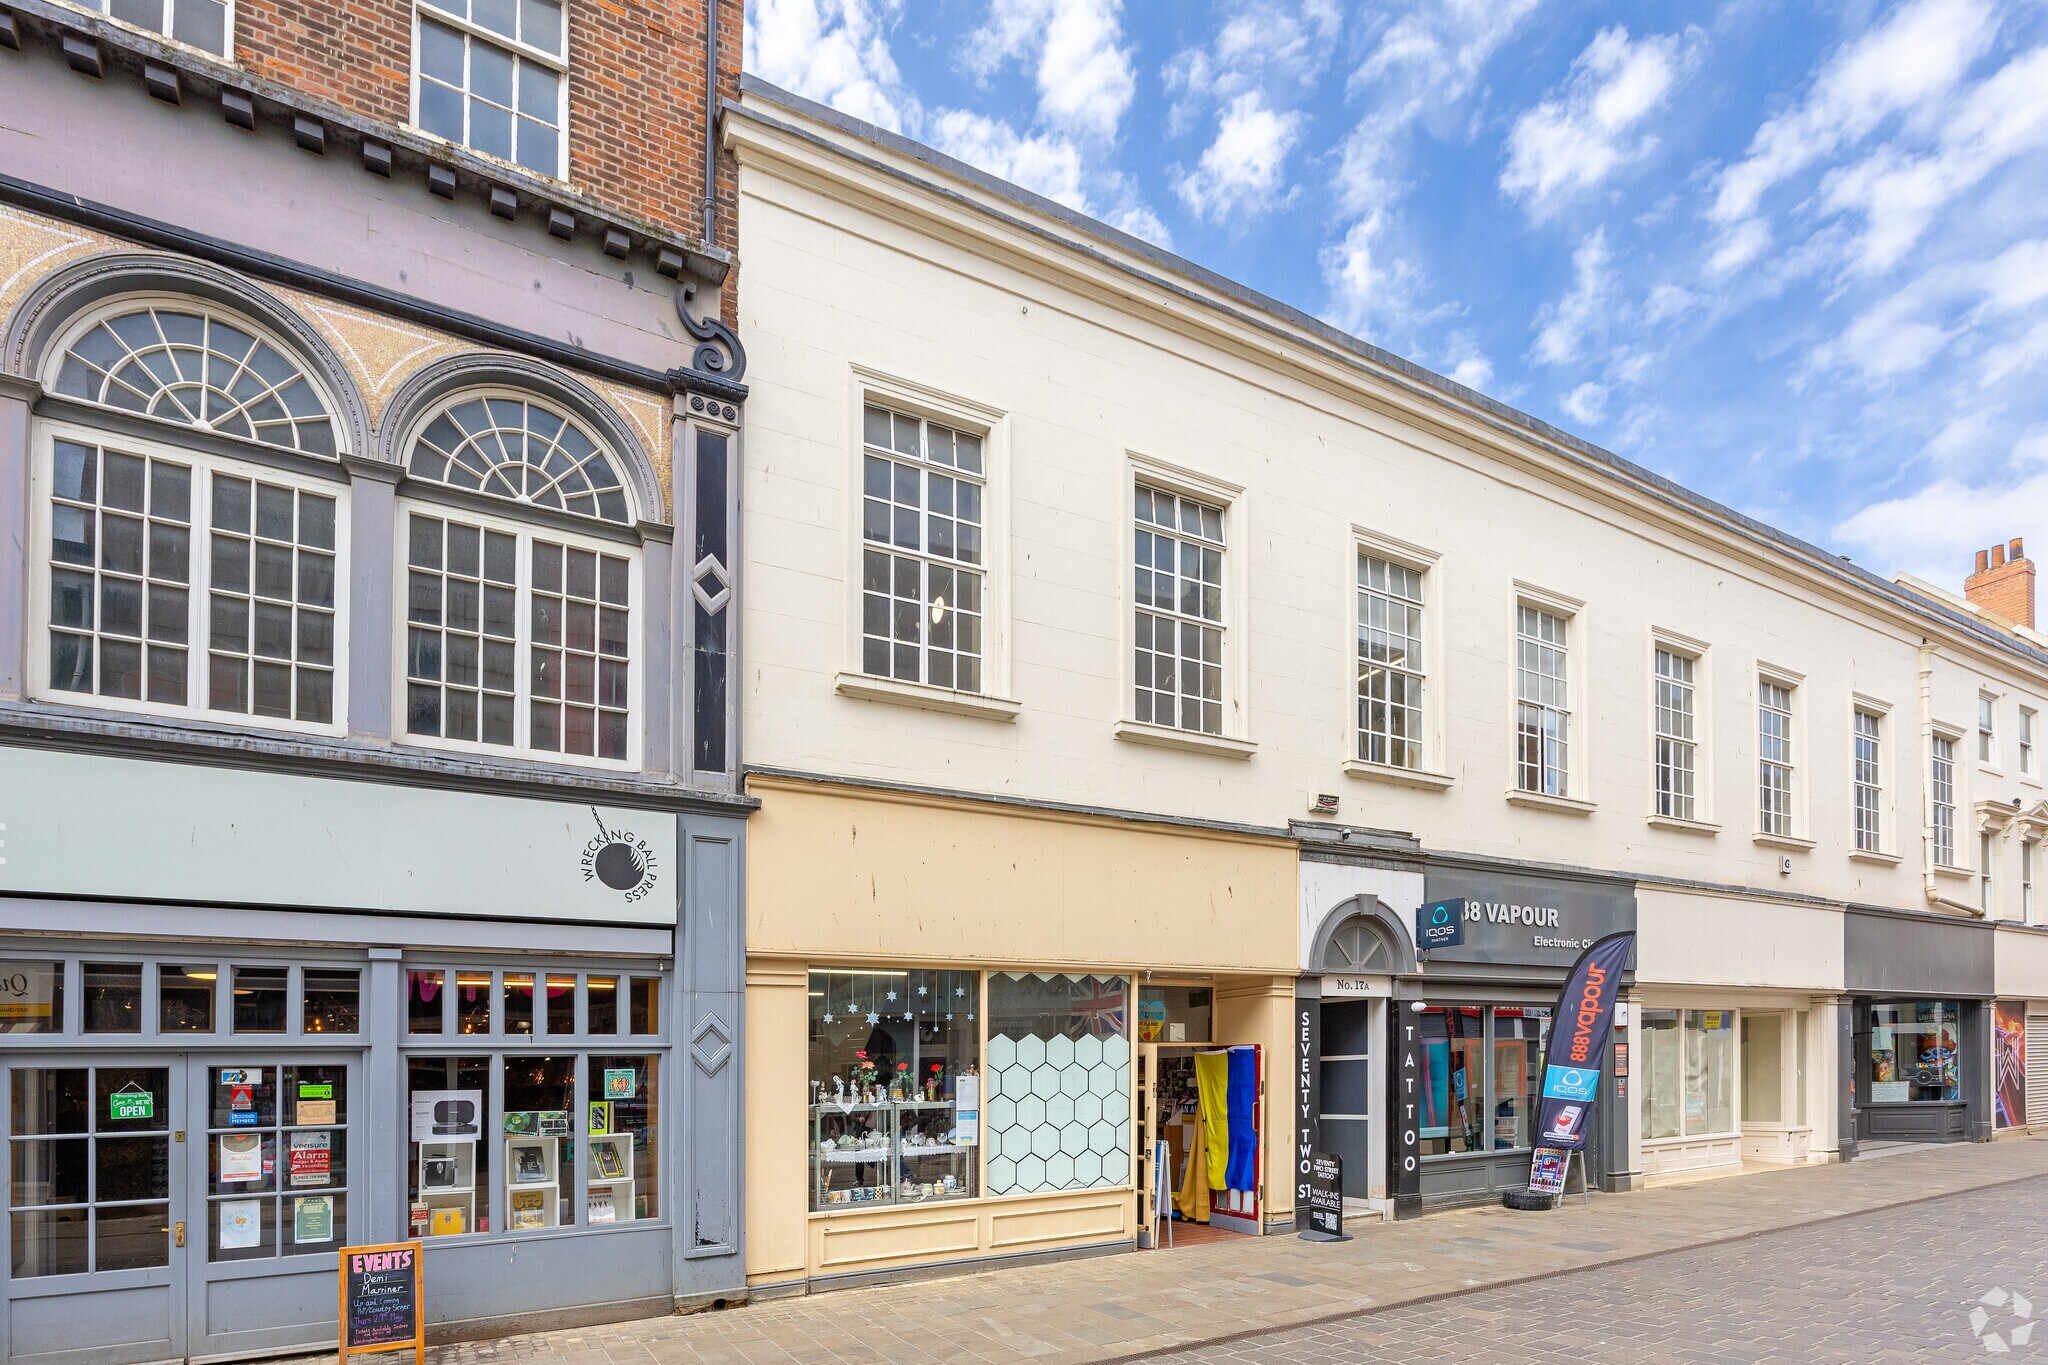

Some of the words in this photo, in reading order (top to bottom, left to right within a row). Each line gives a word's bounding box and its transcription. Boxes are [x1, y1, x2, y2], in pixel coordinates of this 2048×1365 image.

[637, 840, 657, 869] BALL
[625, 873, 657, 903] PRESS
[1485, 902, 1559, 928] VAPOUR
[1426, 926, 1454, 937] IQOS
[1534, 935, 1579, 949] Electronic
[1337, 979, 1352, 990] No.
[1355, 980, 1370, 990] 17A
[1570, 962, 1607, 1063] 888vapour
[1300, 1011, 1311, 1119] SEVENTY
[1553, 1084, 1588, 1095] IQOS
[1404, 1026, 1415, 1172] TATTOO
[120, 1106, 146, 1117] OPEN
[1300, 1128, 1311, 1174] TWO
[1316, 1159, 1335, 1167] SEVENTY
[1317, 1172, 1335, 1180] TATTOO
[1324, 1166, 1339, 1174] STREET
[1312, 1188, 1340, 1200] WALK-INS
[514, 1198, 542, 1208] UFO
[1311, 1196, 1340, 1209] AVAILABLE
[353, 1250, 413, 1274] EVENTS
[364, 1273, 388, 1284] Demi
[361, 1285, 403, 1296] Marriner
[354, 1317, 371, 1325] Thurs
[391, 1312, 403, 1323] May
